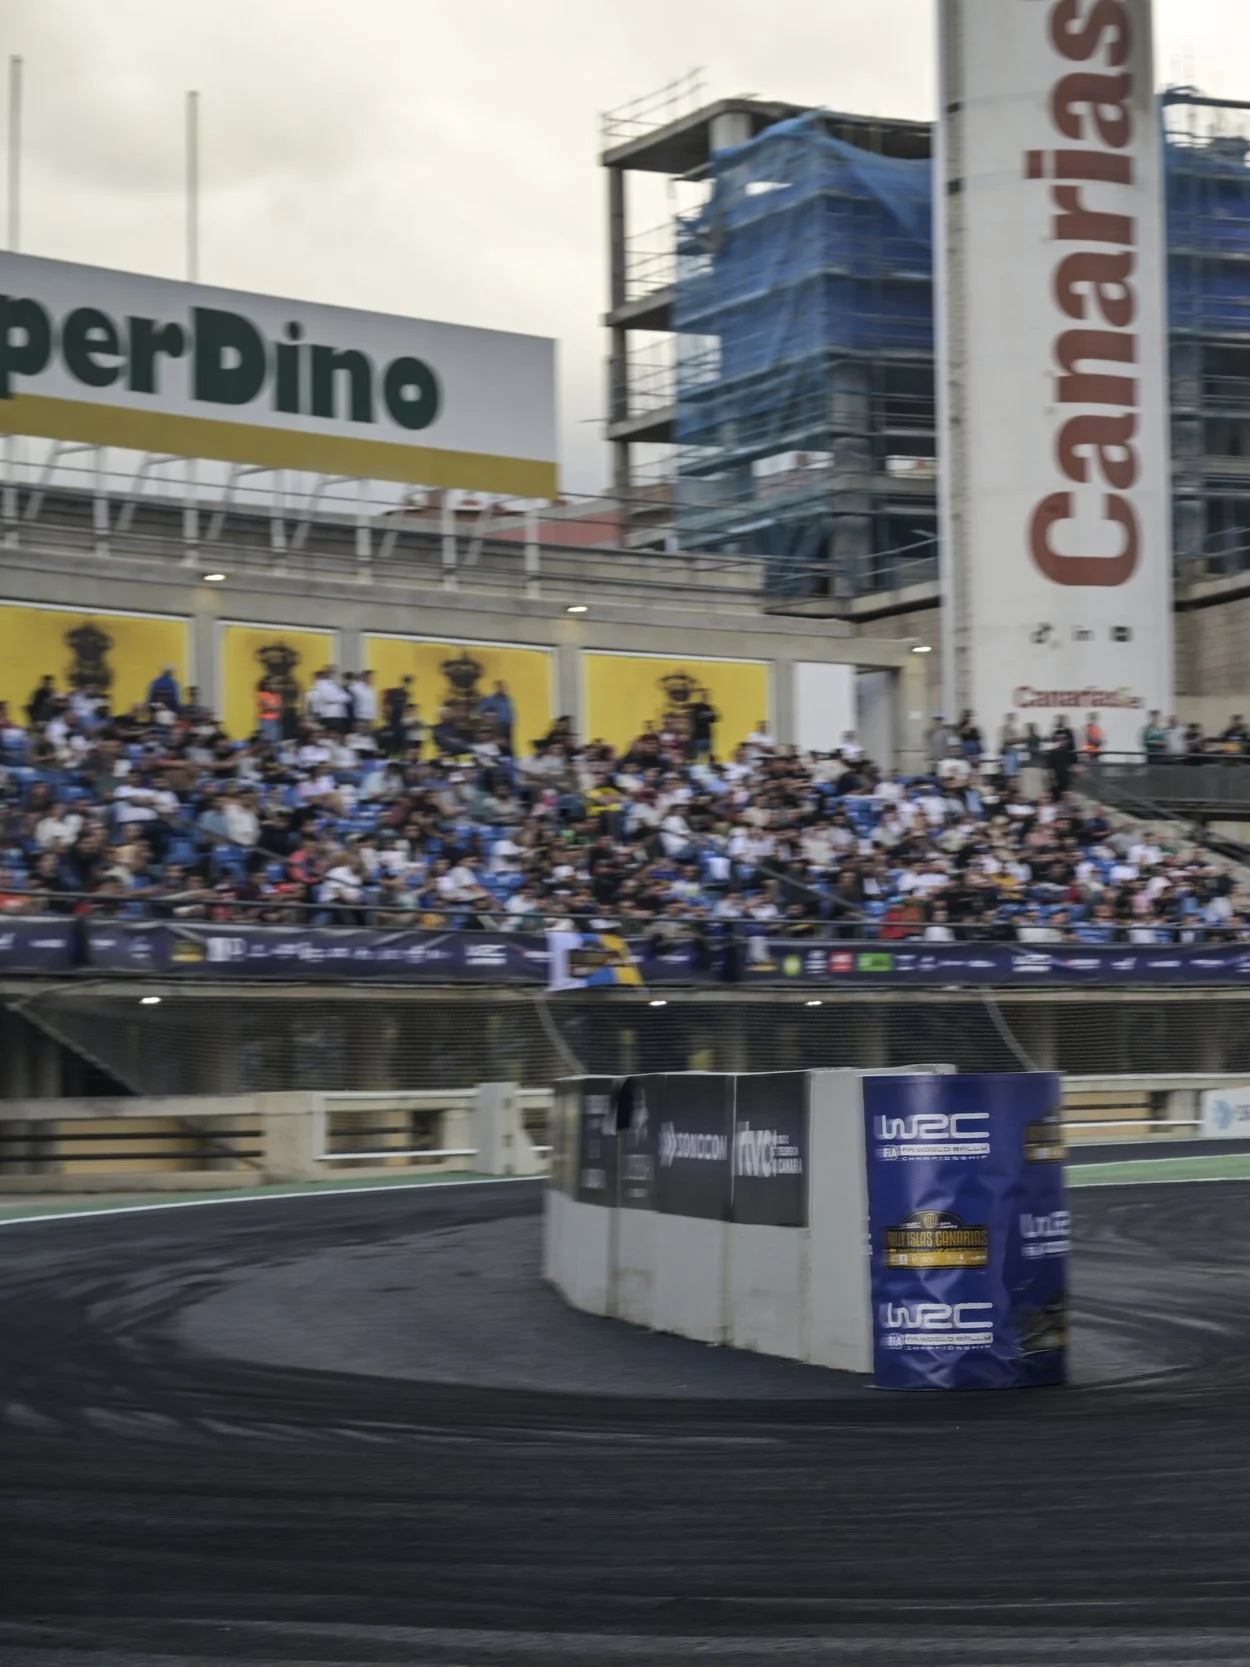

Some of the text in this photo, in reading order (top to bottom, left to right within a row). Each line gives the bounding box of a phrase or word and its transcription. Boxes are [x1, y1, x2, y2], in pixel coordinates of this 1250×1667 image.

[1022, 0, 1141, 587] Canarias
[875, 1113, 990, 1139] WRC
[907, 1231, 933, 1247] ISLAS
[935, 1230, 988, 1247] CANARIAS
[880, 1302, 993, 1329] WRC
